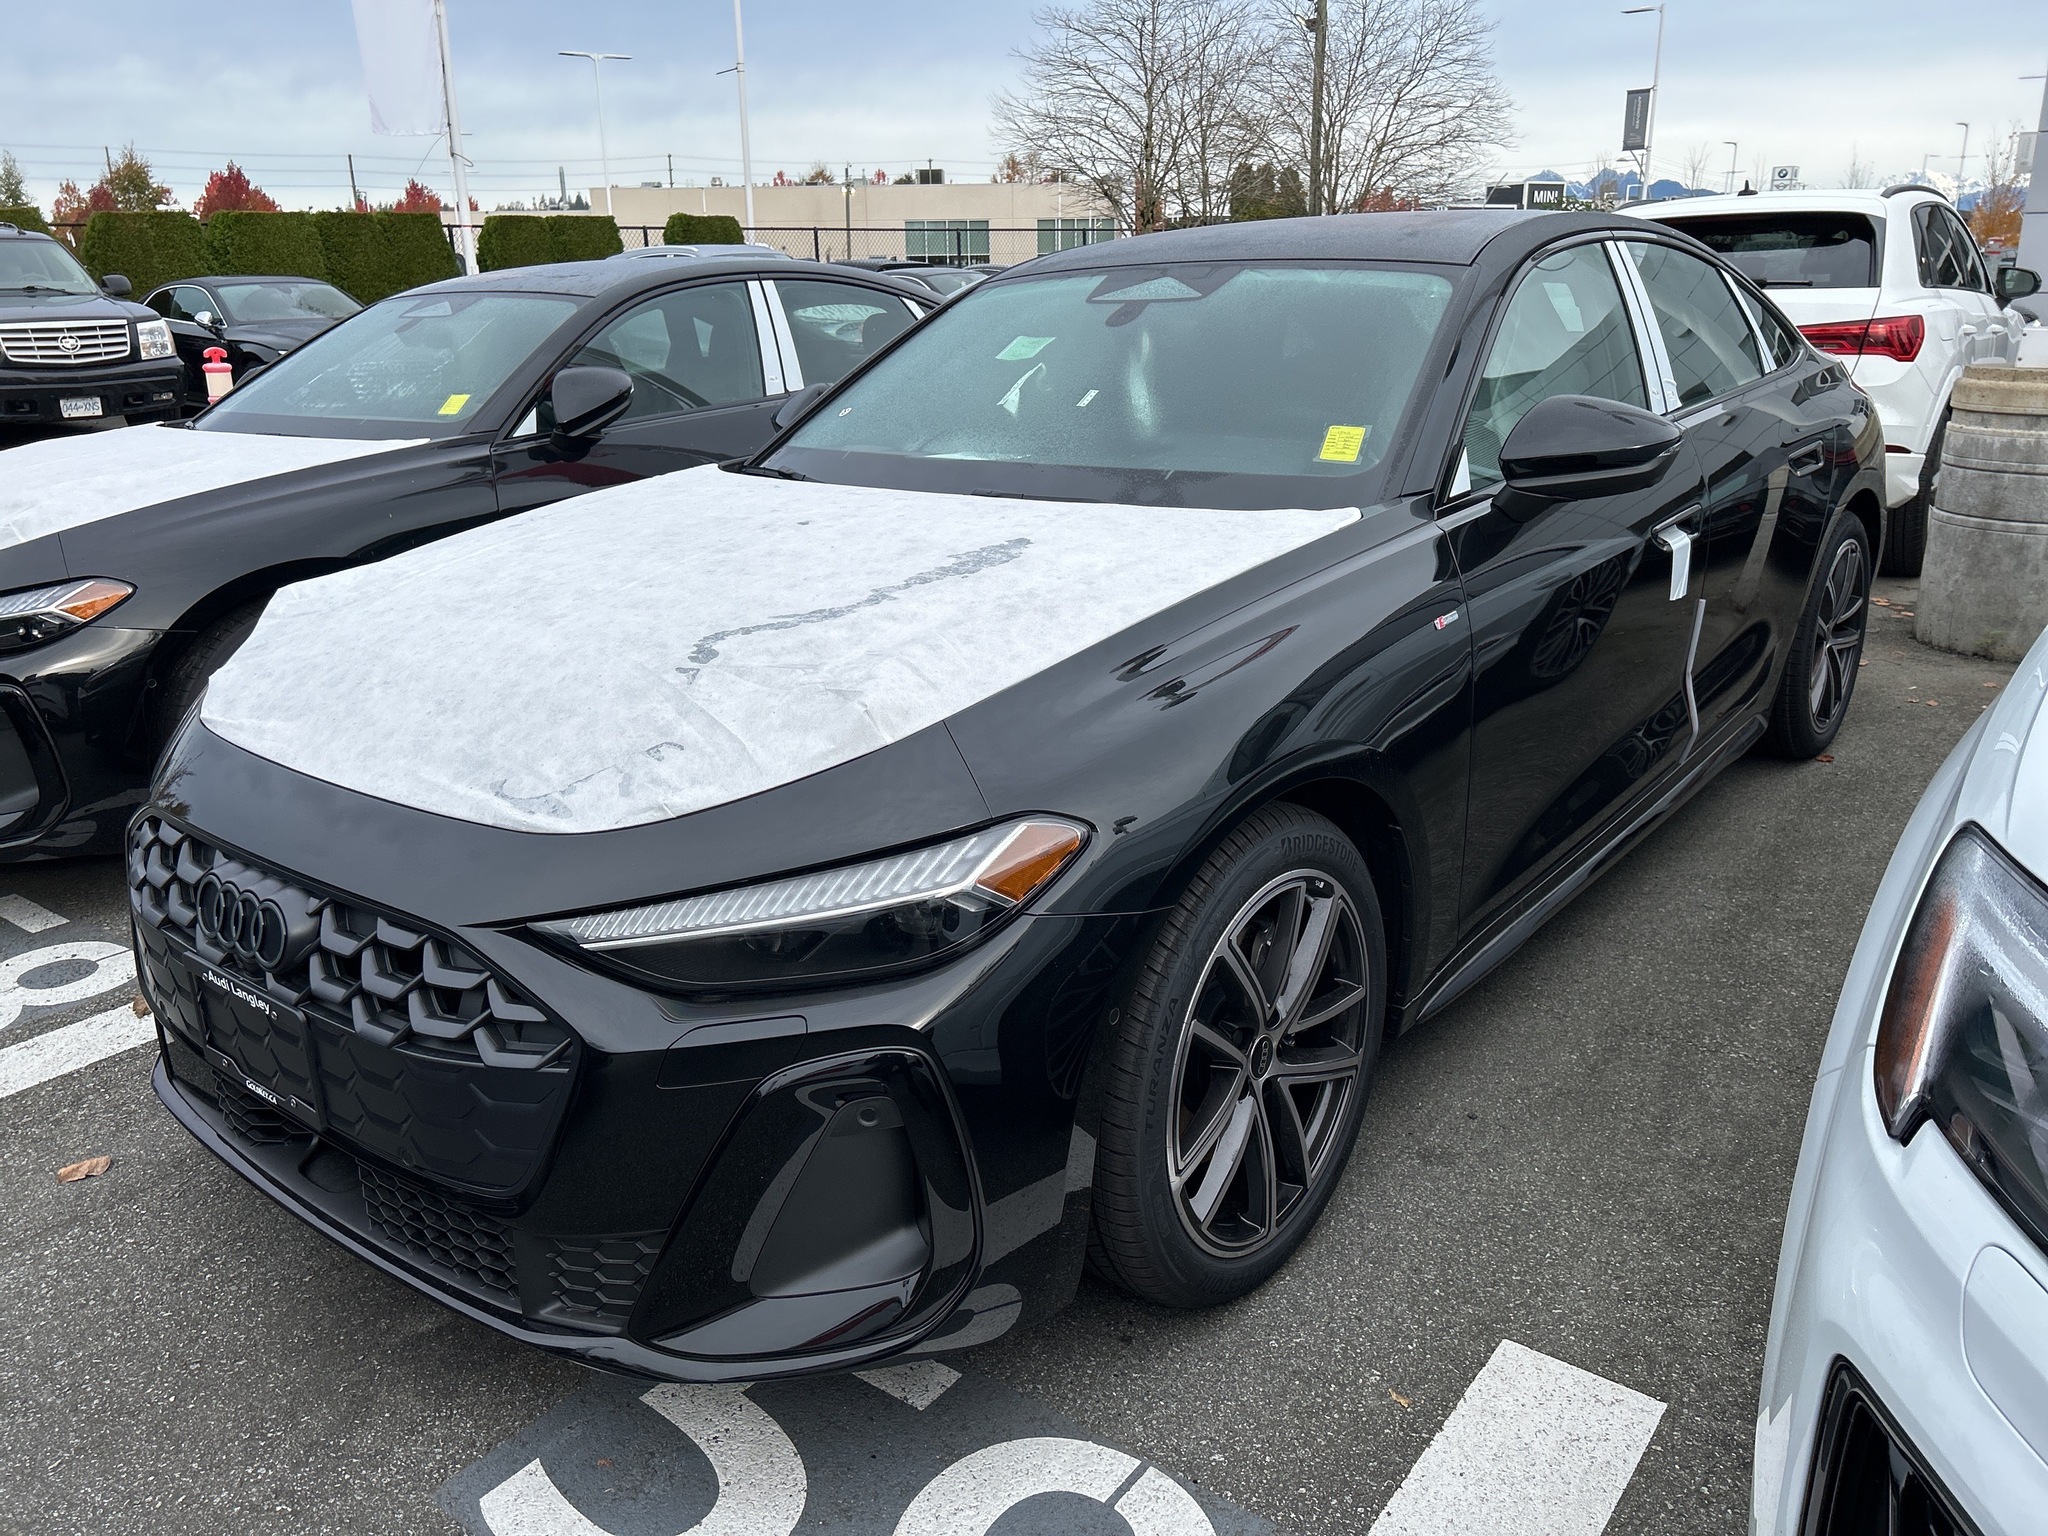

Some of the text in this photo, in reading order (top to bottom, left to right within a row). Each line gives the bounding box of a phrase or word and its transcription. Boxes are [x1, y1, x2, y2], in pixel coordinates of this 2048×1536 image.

[1280, 834, 1359, 873] BRIDGESTONE
[208, 970, 270, 1015] Audi Langley
[1144, 997, 1179, 1135] TURANZA
